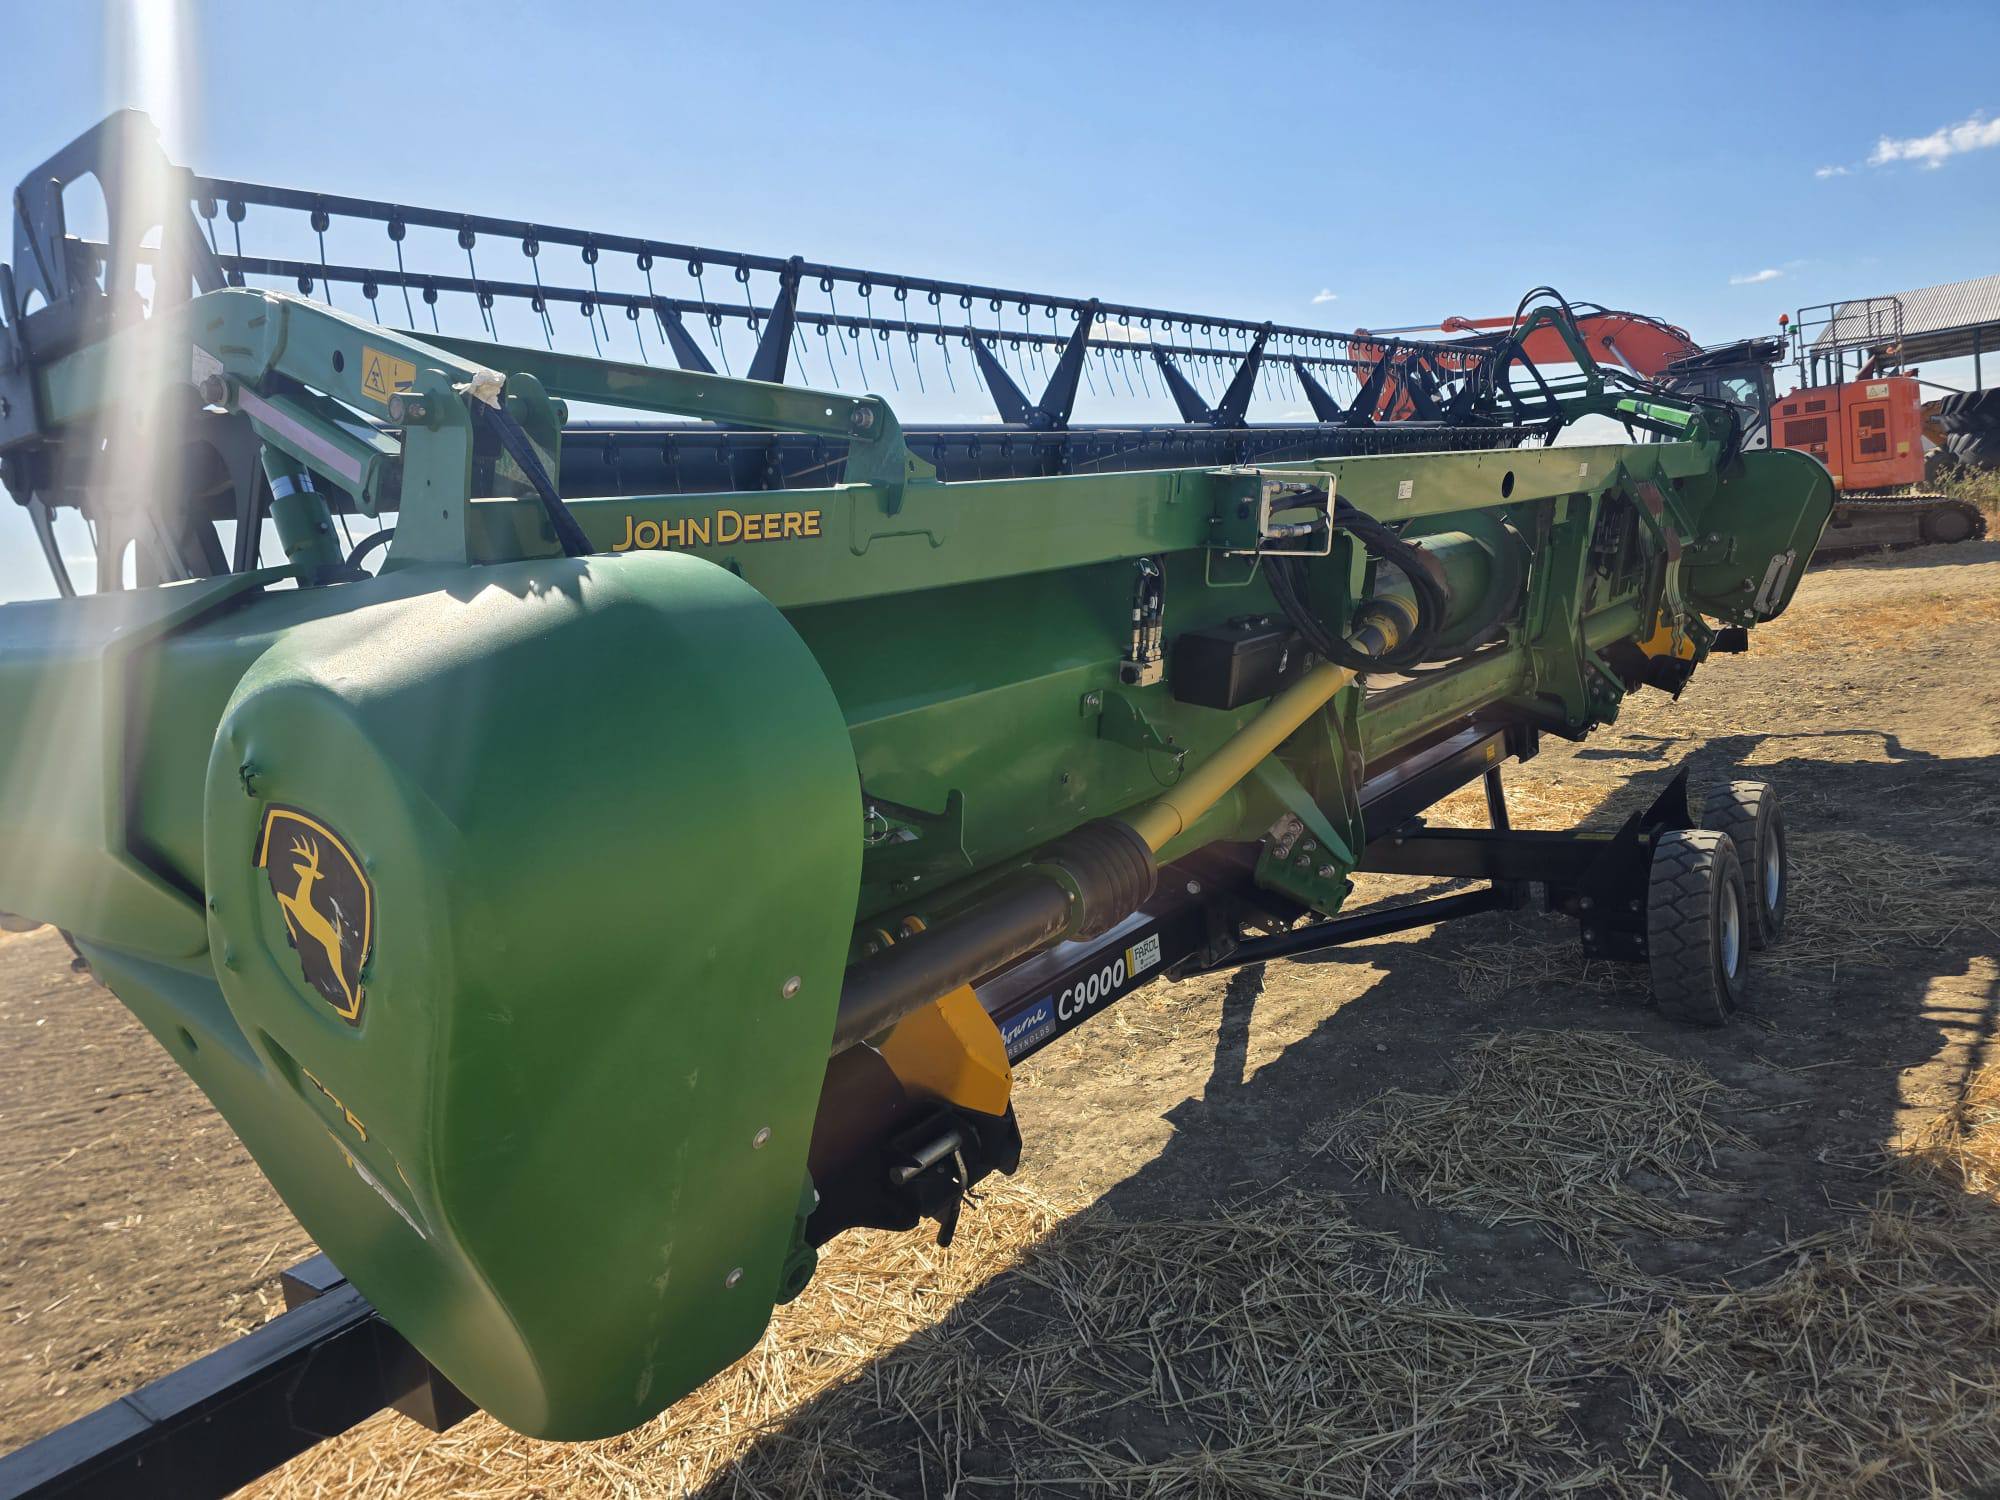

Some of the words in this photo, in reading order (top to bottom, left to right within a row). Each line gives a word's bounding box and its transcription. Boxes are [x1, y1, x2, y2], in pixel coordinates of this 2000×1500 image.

[612, 515, 711, 552] JOHN
[717, 510, 822, 543] DEERE
[1134, 938, 1159, 960] FAROL
[1058, 957, 1125, 1021] C9000
[1008, 1025, 1050, 1056] REYNOLDS
